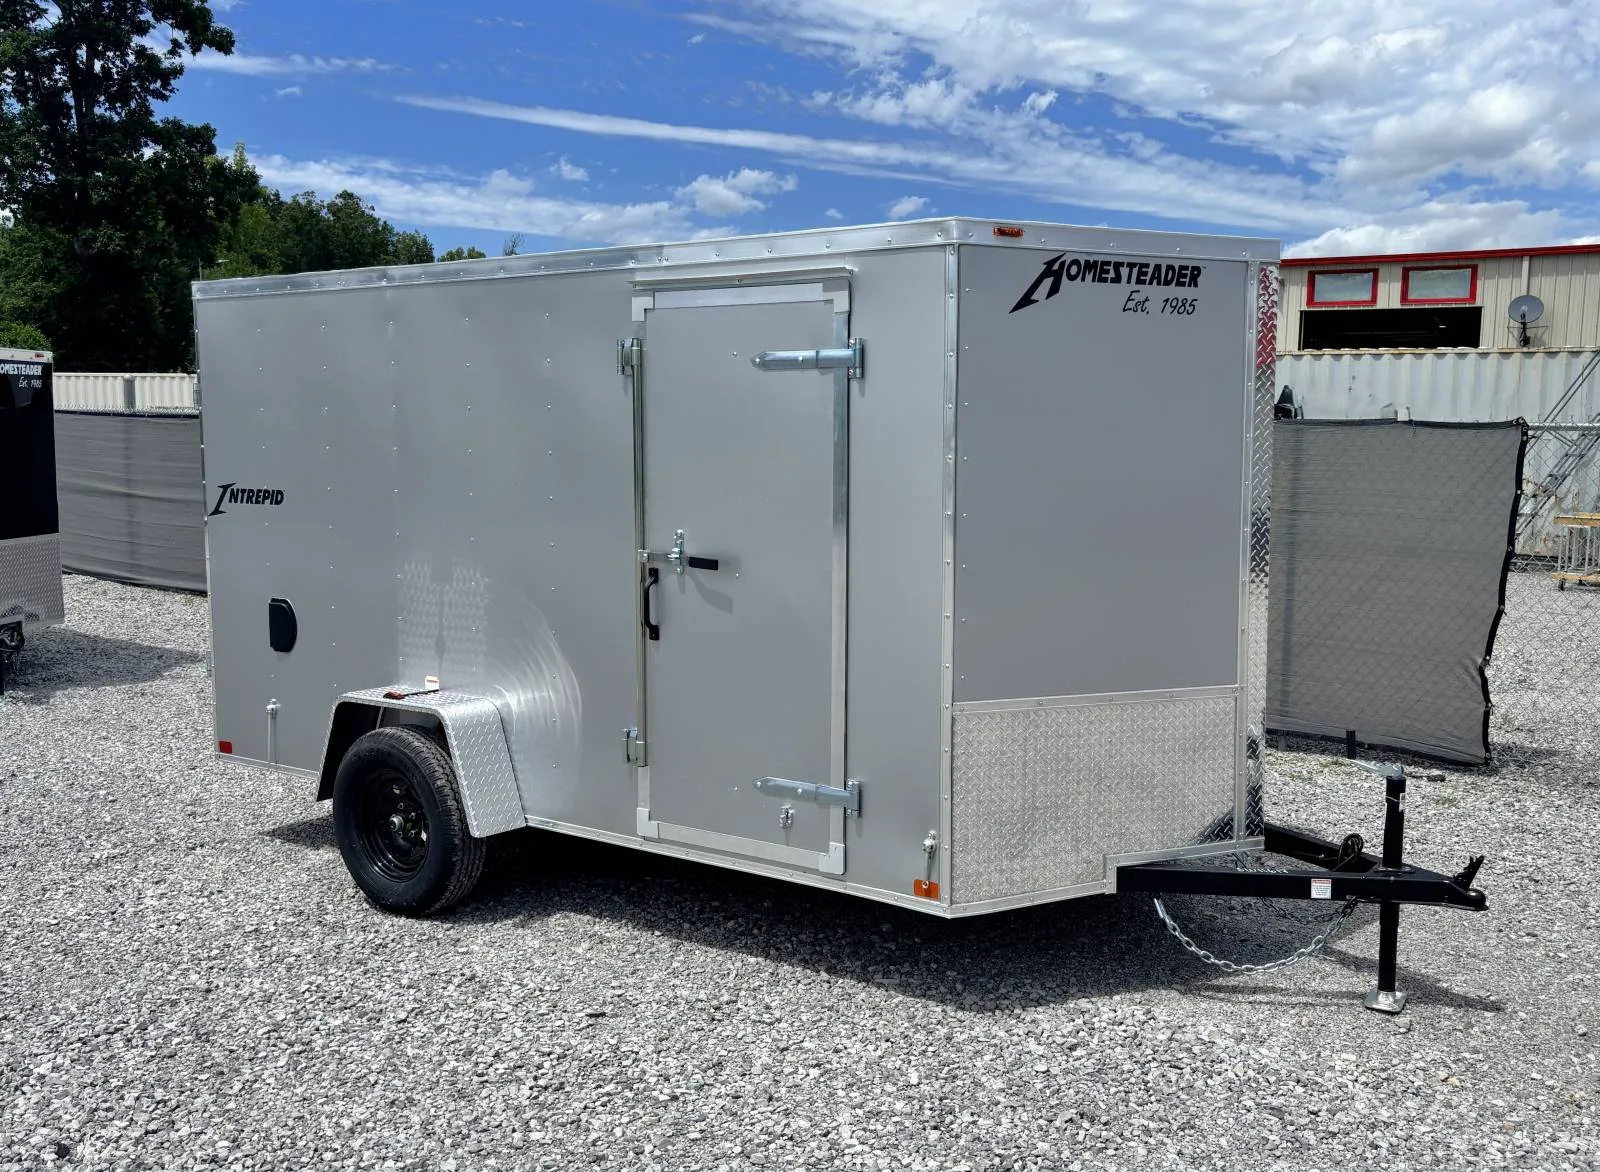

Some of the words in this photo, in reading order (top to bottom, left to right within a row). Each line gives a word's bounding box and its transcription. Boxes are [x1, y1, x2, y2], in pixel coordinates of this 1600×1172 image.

[1009, 253, 1201, 314] HOMESTEADER
[1161, 297, 1198, 315] 1985
[0, 363, 42, 375] OMESTEADER
[208, 482, 285, 516] INTREPID
